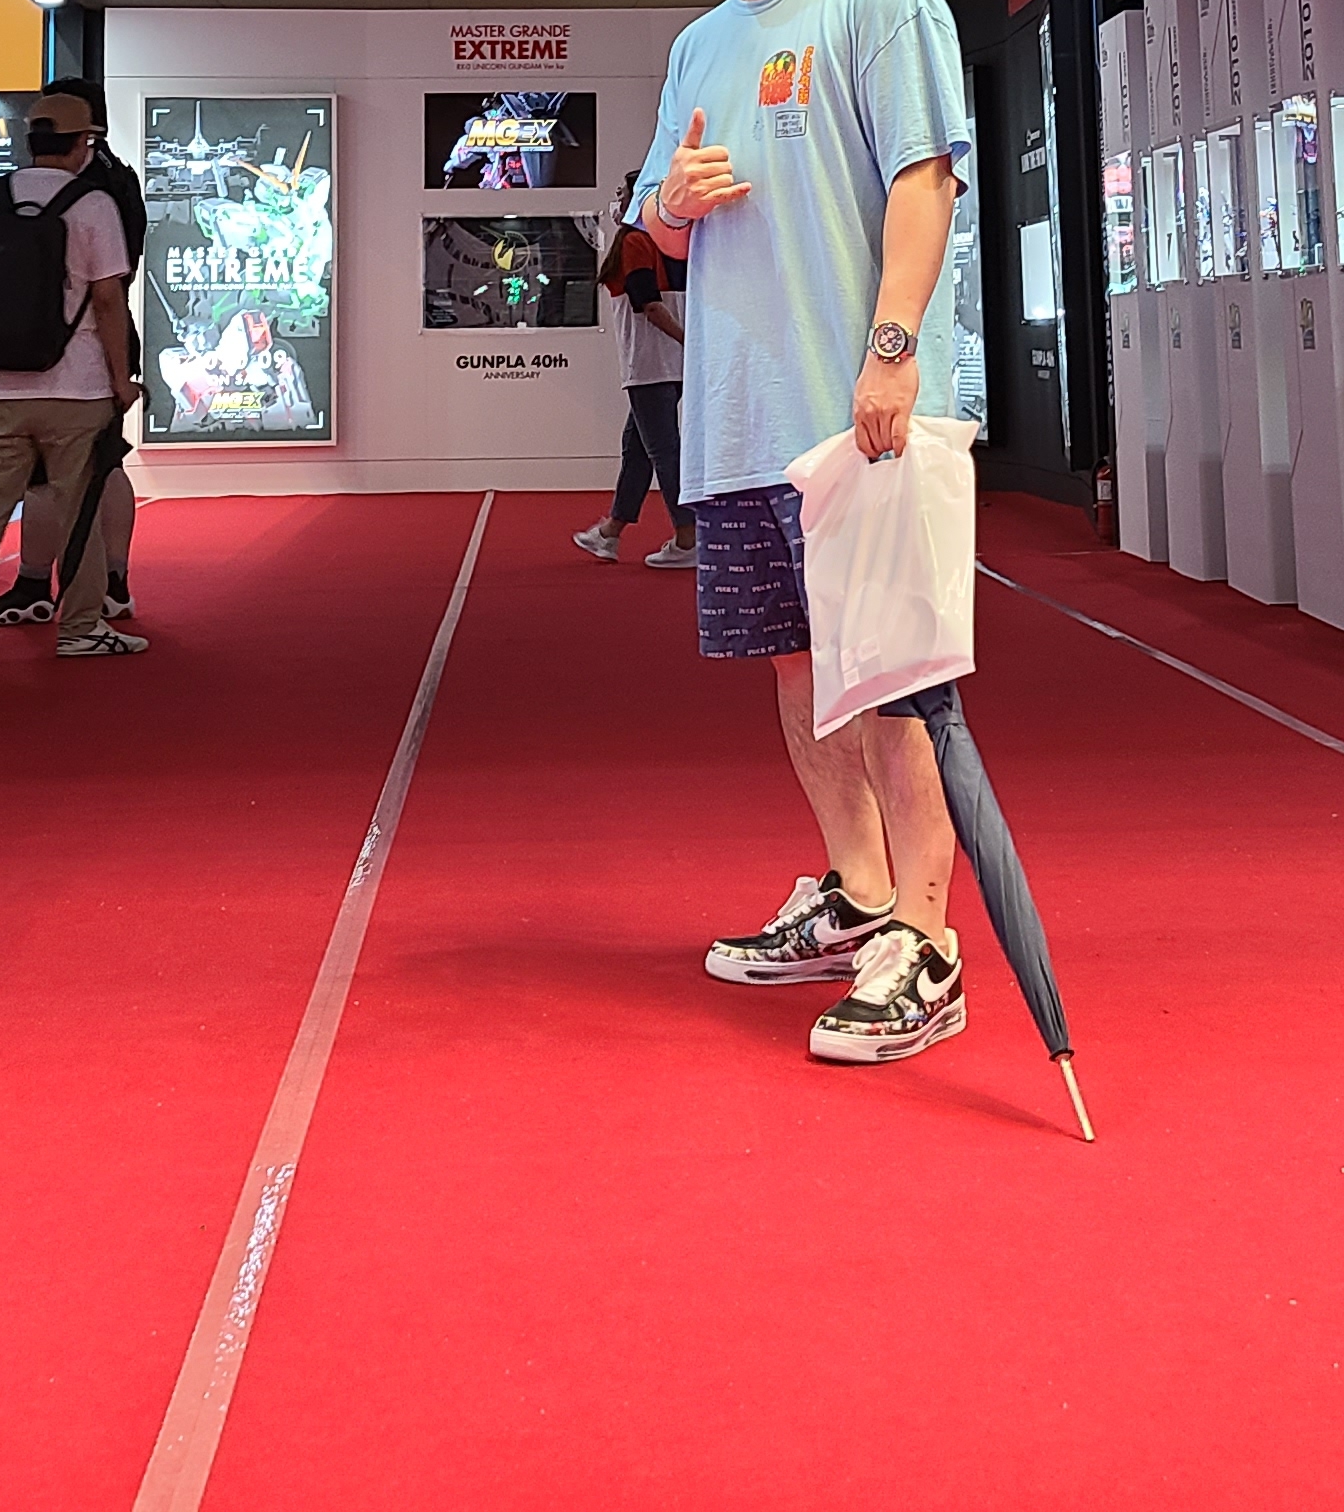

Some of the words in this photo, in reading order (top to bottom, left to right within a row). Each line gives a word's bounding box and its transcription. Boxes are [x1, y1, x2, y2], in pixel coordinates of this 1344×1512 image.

[450, 25, 506, 38] MASTER
[509, 24, 571, 38] GRANDE
[454, 39, 568, 61] EXTREME
[465, 118, 558, 148] MGEX
[166, 257, 309, 284] EXTREME
[455, 355, 526, 370] GUNPLA
[530, 353, 569, 369] 40th
[482, 371, 541, 381] ANNIVERSARY
